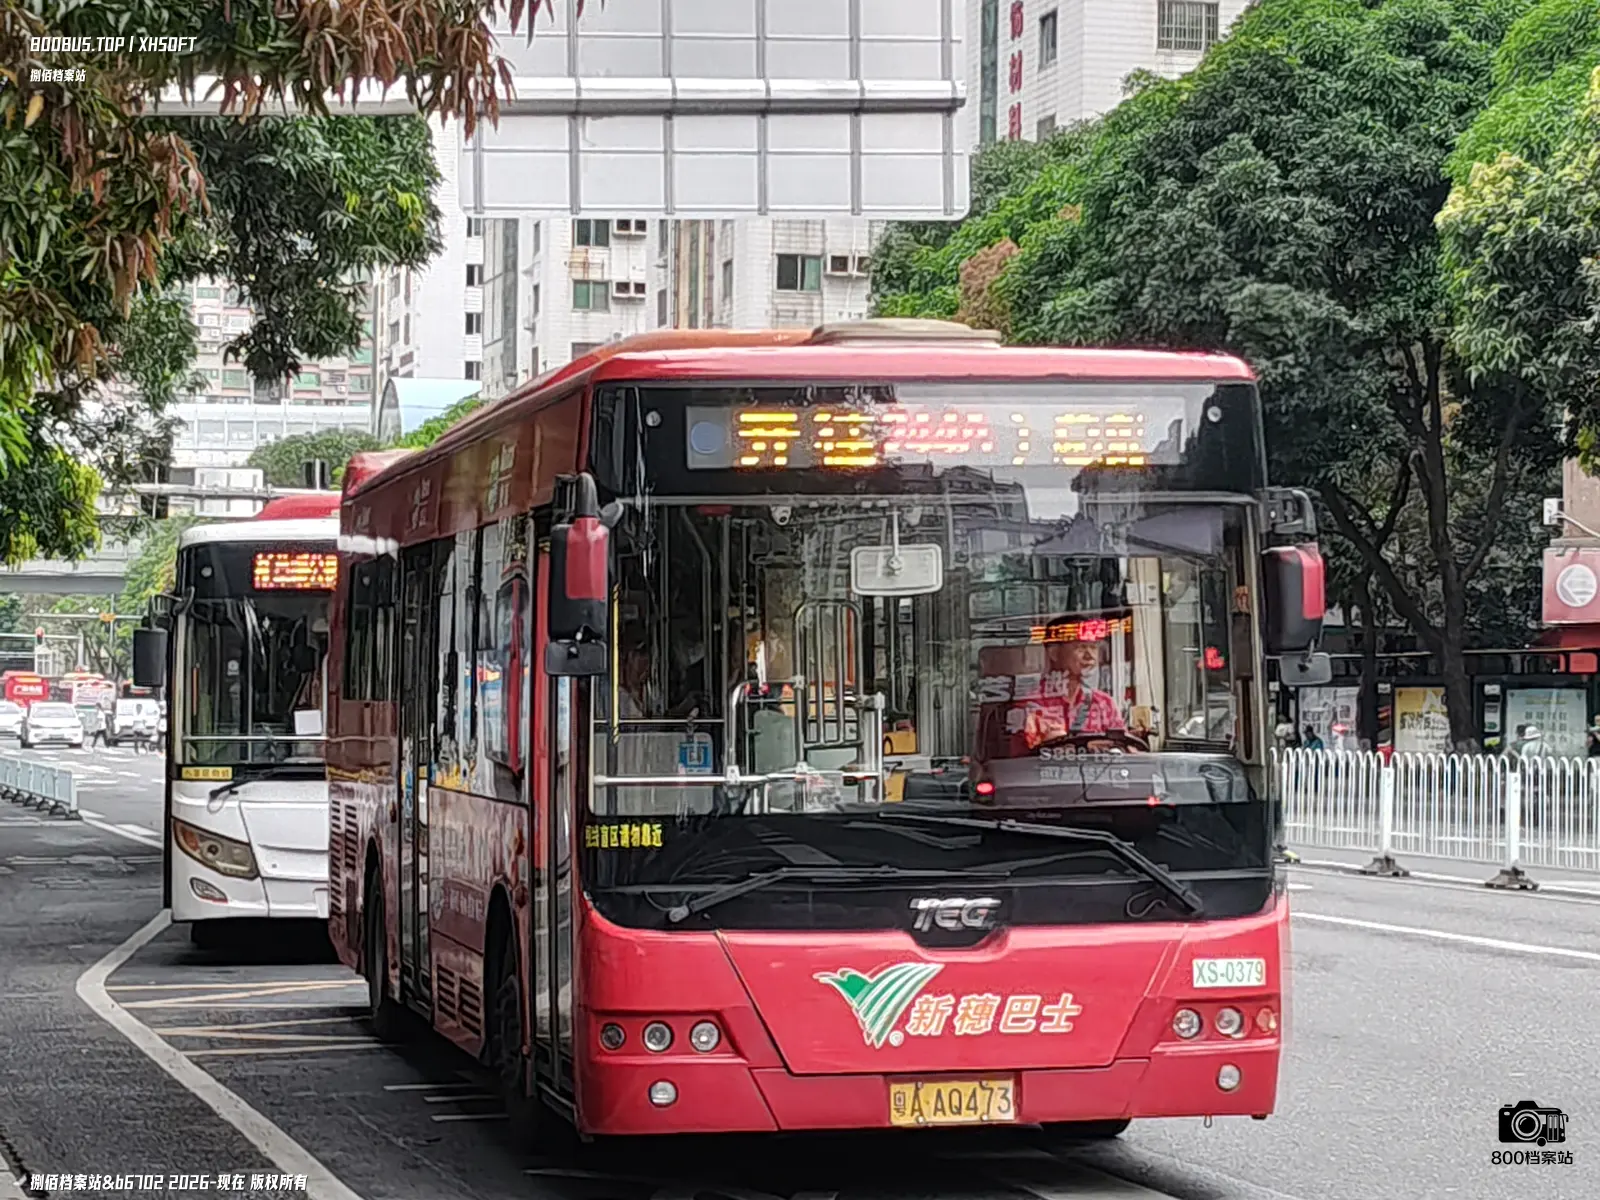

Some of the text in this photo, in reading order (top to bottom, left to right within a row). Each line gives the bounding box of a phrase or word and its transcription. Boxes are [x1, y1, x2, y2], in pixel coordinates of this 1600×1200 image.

[1195, 960, 1264, 984] XS-0379
[905, 992, 1083, 1037] 新穗巴士
